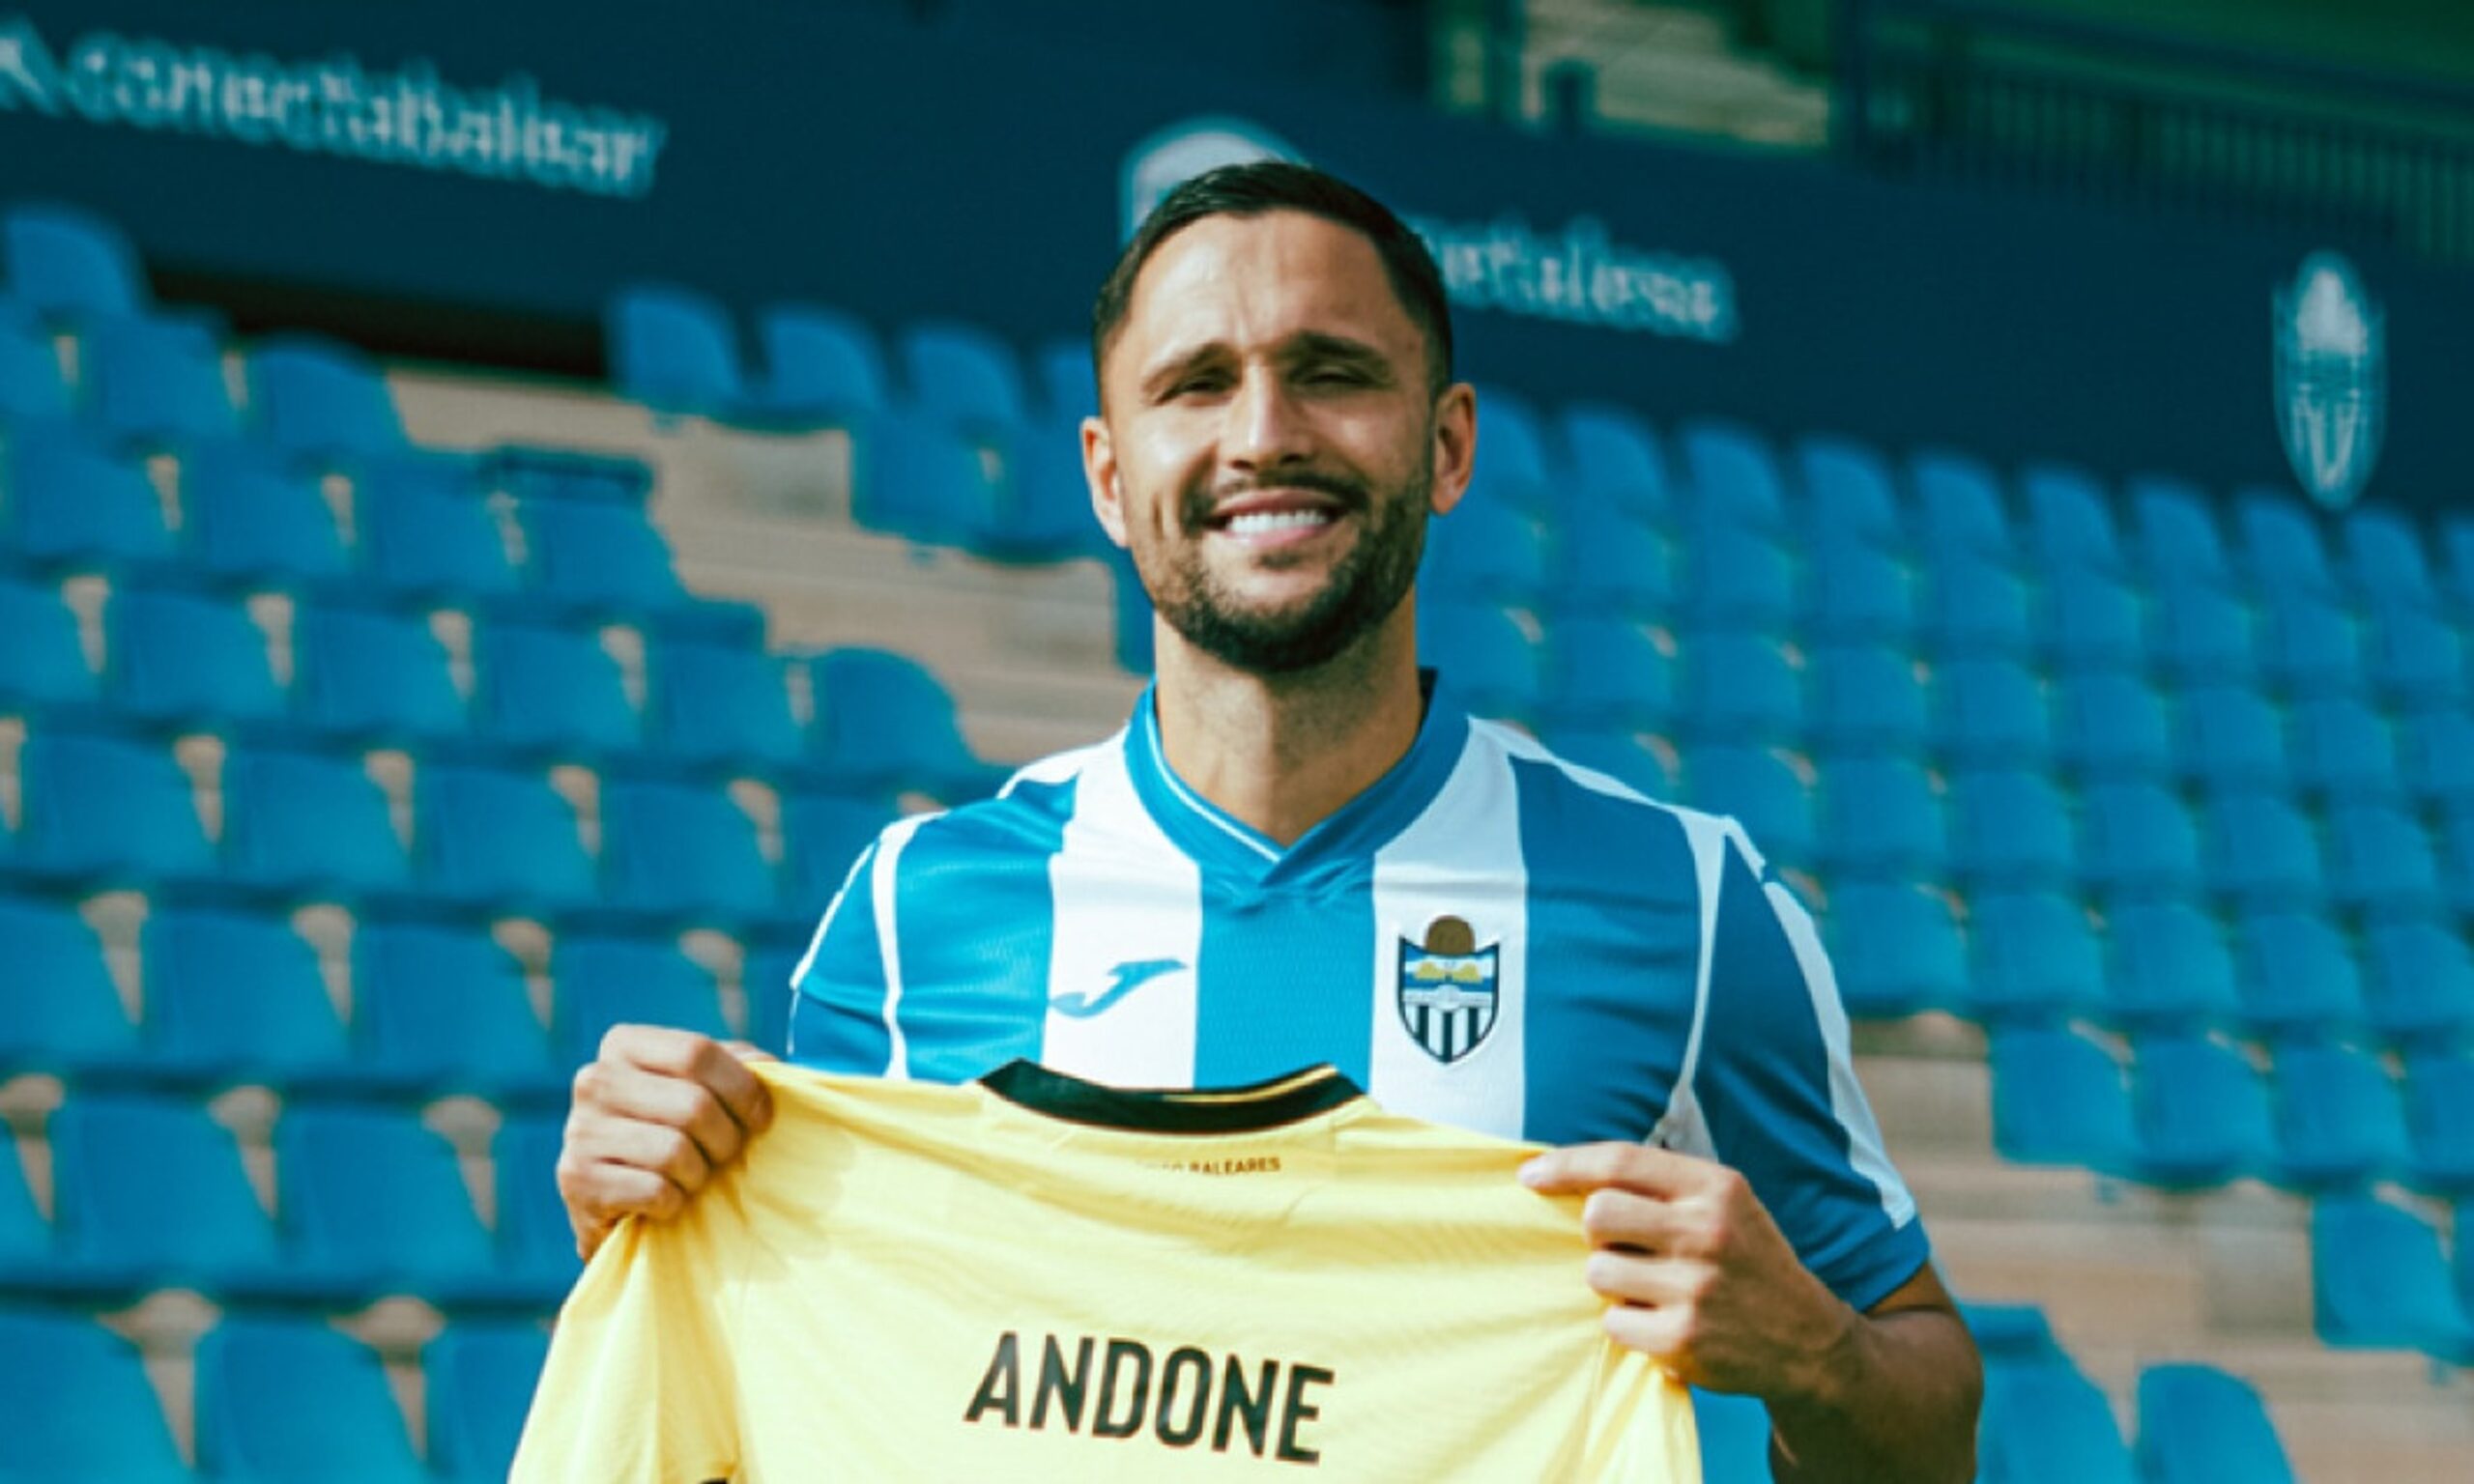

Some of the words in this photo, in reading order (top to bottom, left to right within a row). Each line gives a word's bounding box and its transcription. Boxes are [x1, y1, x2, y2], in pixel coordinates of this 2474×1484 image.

[68, 34, 667, 199] conectabalear
[1189, 1156, 1281, 1175] BALEARES
[964, 1330, 1335, 1465] ANDONE
